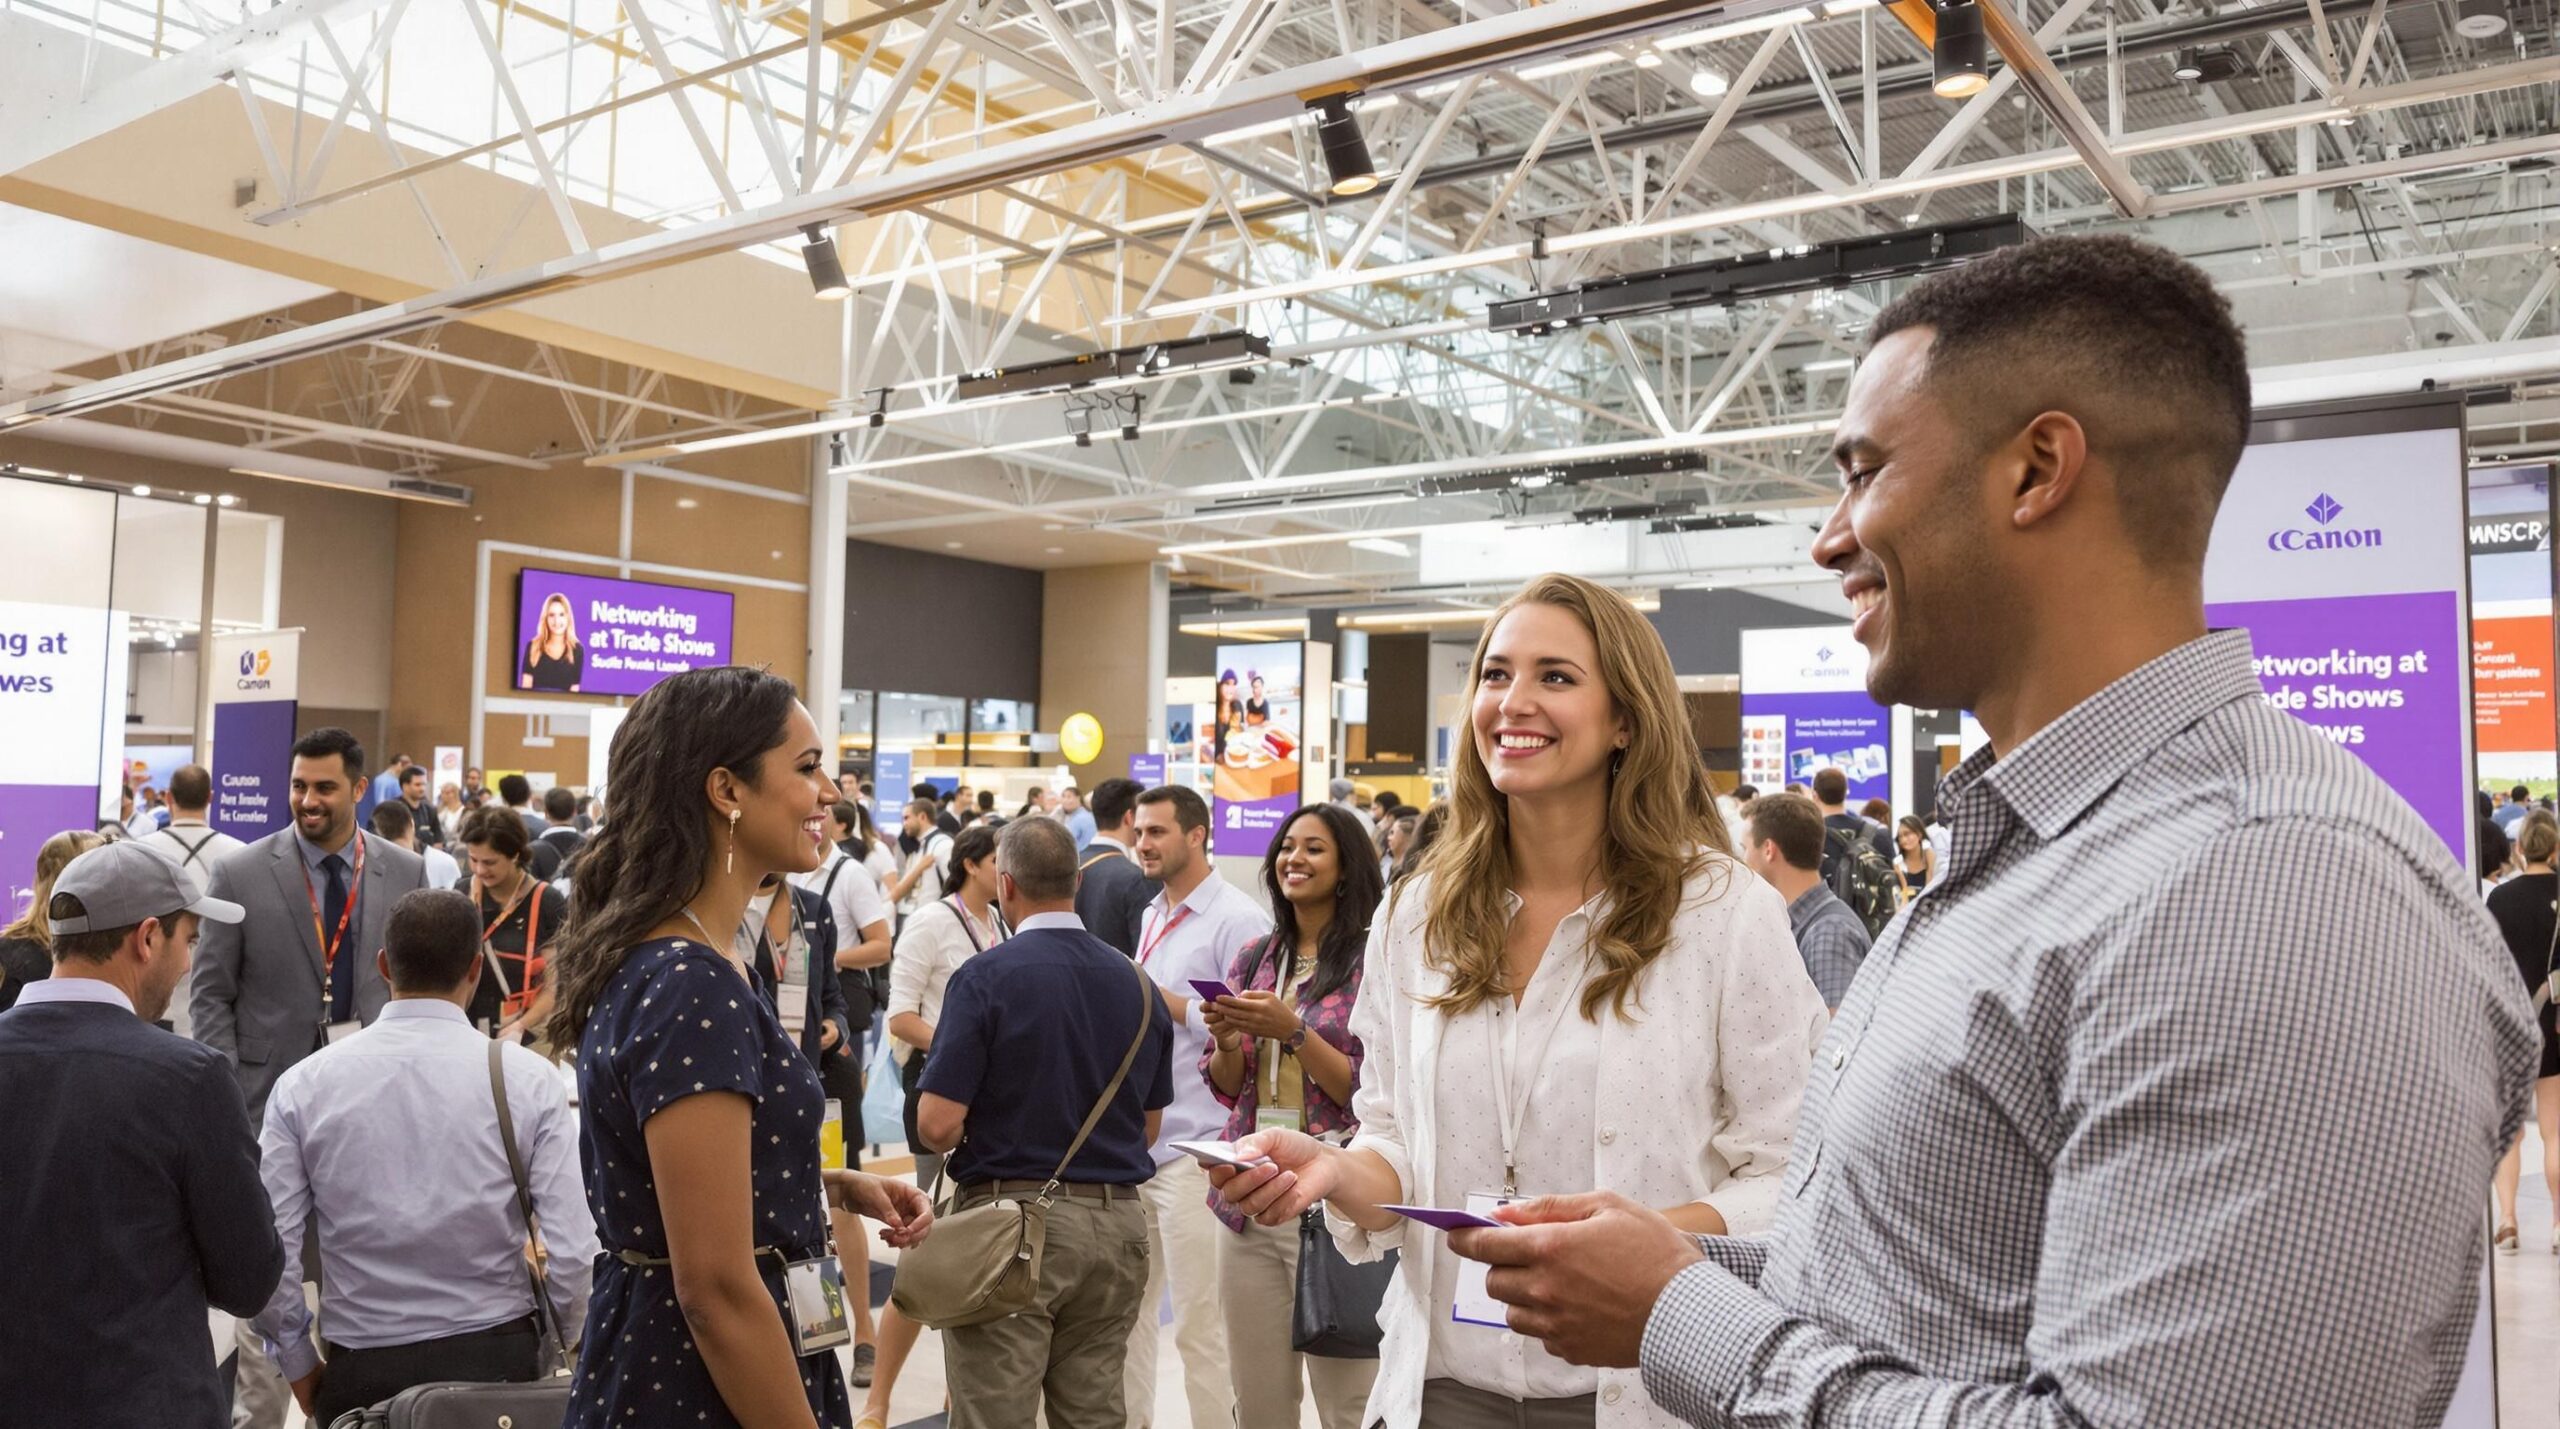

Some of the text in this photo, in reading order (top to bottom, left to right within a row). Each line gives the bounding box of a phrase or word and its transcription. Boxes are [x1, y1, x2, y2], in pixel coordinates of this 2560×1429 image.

[591, 599, 698, 635] Networking
[38, 632, 68, 655] at
[589, 627, 716, 657] at Trade Shows
[2398, 649, 2429, 674] at
[2311, 684, 2405, 710] Shows
